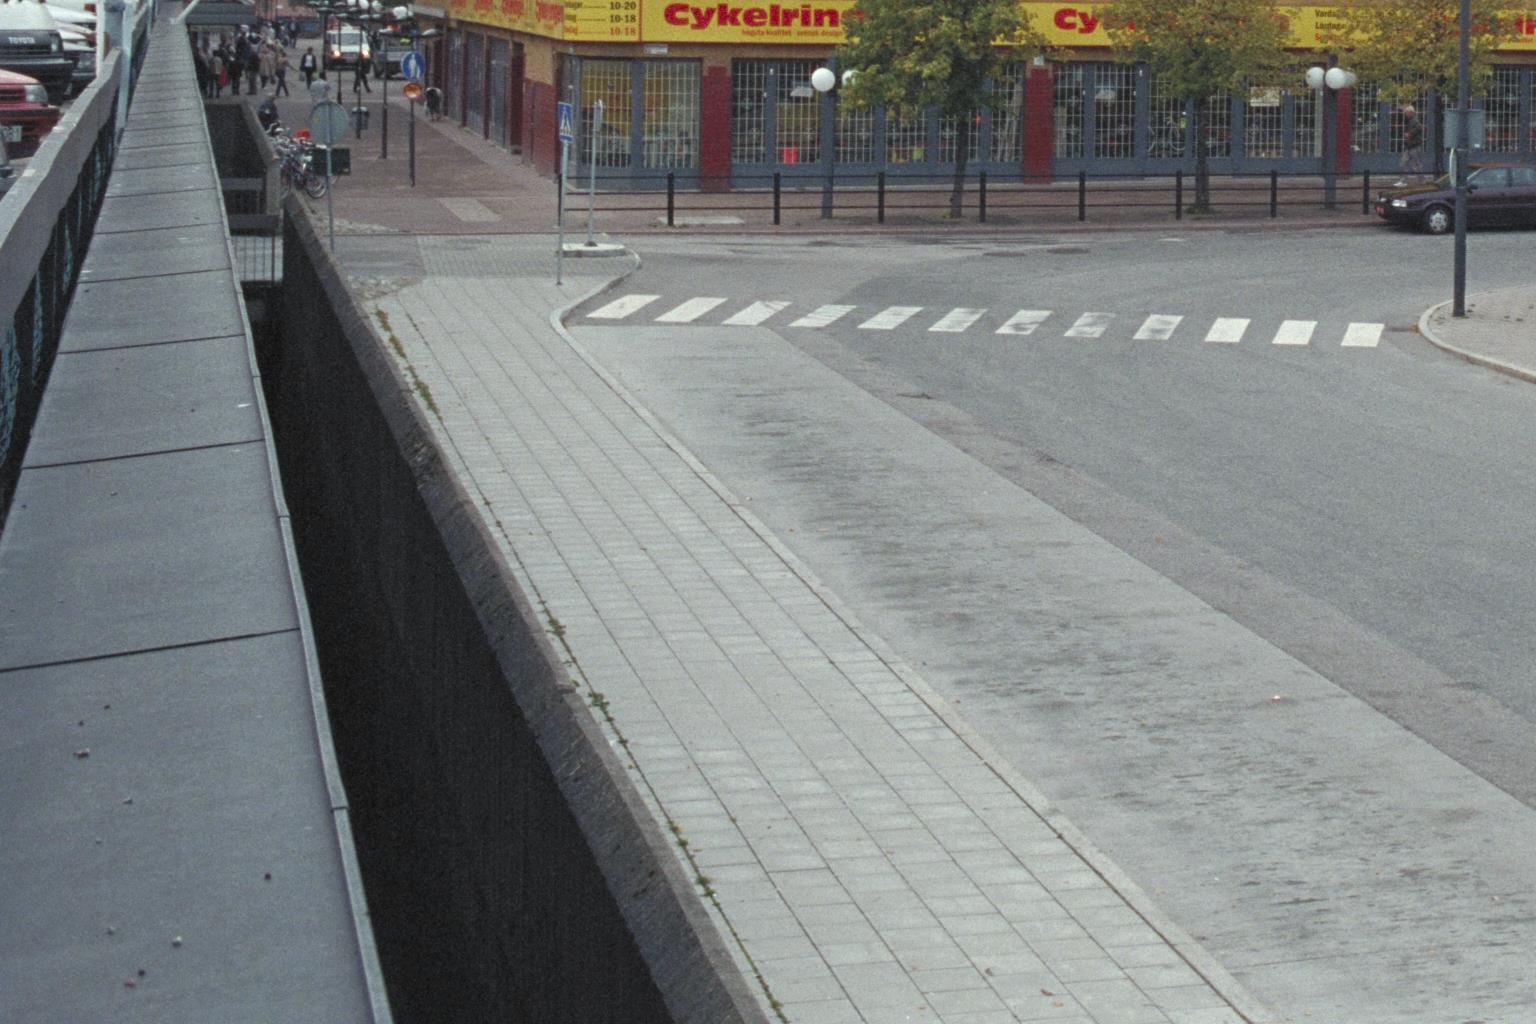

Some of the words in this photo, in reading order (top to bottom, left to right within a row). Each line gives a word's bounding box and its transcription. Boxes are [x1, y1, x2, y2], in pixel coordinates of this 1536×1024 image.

[609, 1, 637, 11] 10-20
[609, 14, 637, 24] 10-18
[664, 2, 865, 30] Cykelrin
[609, 26, 636, 36] 10-18
[8, 36, 36, 45] TOYOTA
